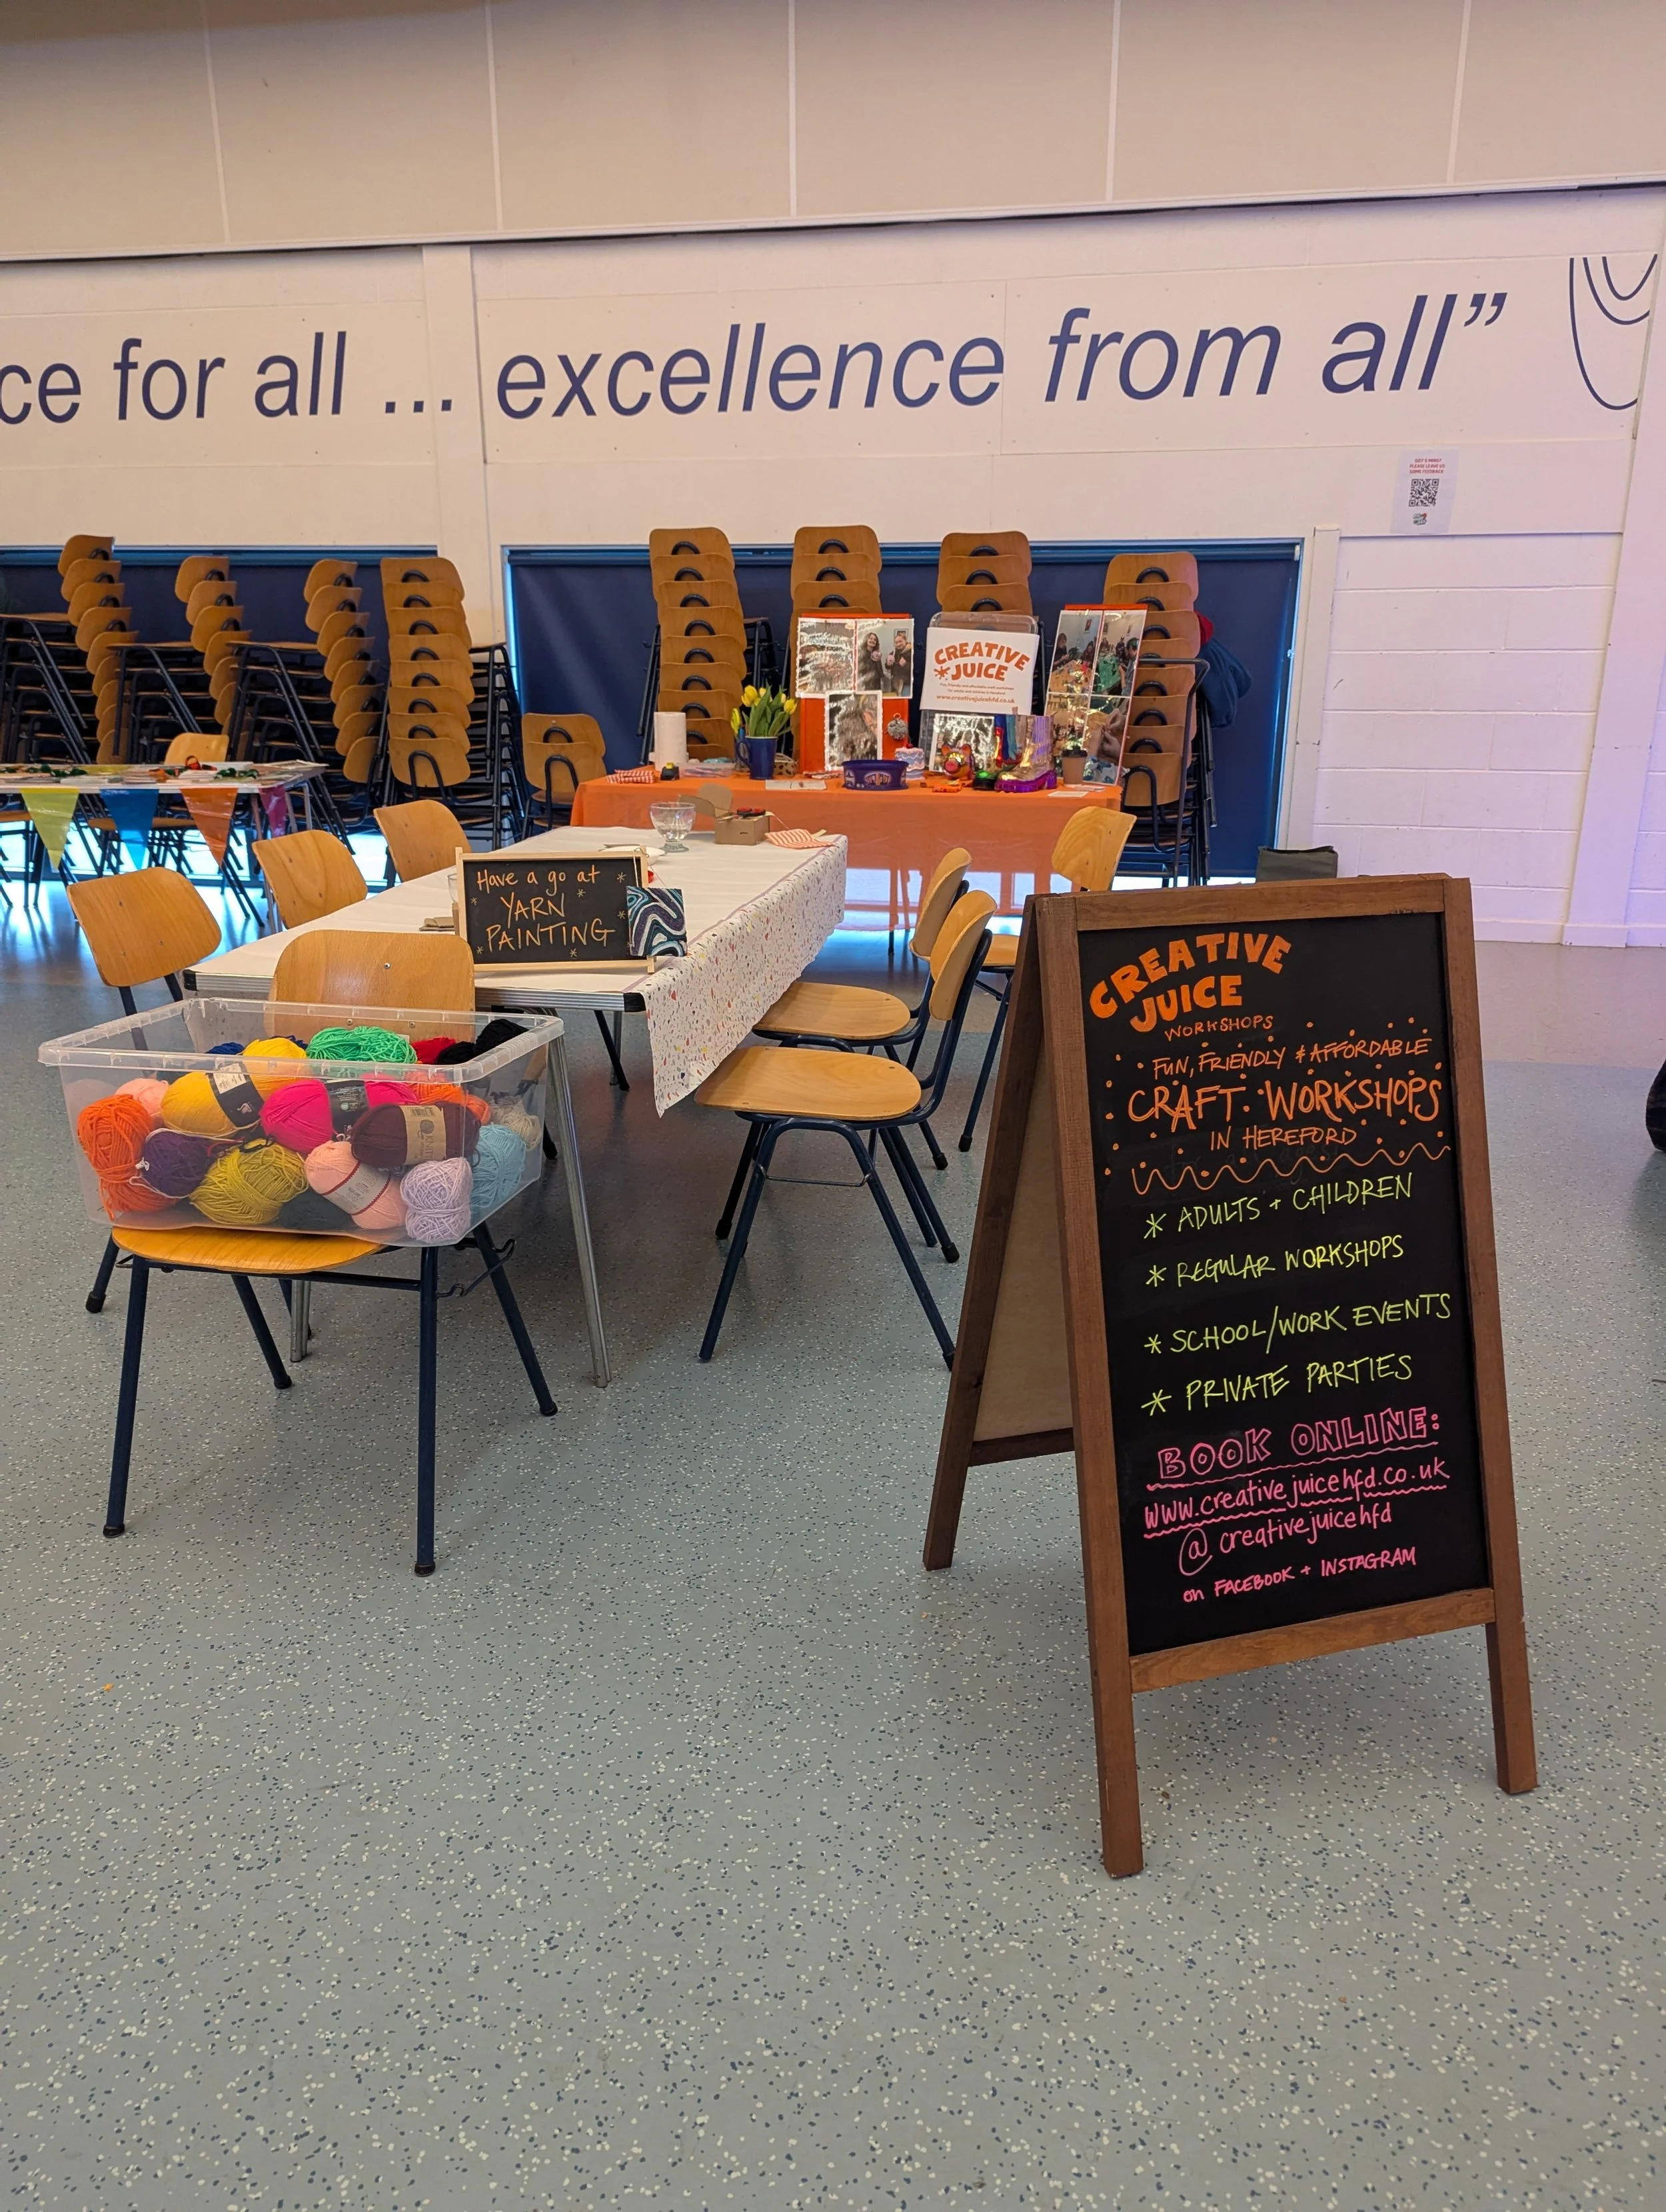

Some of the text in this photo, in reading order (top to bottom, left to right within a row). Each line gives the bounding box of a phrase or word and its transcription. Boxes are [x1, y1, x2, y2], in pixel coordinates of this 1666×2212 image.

[114, 337, 225, 420] for
[254, 330, 347, 416] all
[496, 322, 1004, 419] excellence
[1045, 306, 1281, 402] from
[935, 642, 1030, 671] CREATIVE
[951, 662, 1008, 682] JUICE
[936, 695, 1015, 704] www.creativejuicehfd.co.uk
[477, 864, 600, 896] Have a go at
[486, 918, 615, 952] PAINTING
[500, 891, 566, 929] YARN
[1089, 931, 1291, 1018] CREATIVE
[1130, 975, 1242, 1032] JUICE
[1165, 1015, 1273, 1041] WORKSHOPS
[1152, 1056, 1194, 1080] FUN,
[1198, 1047, 1286, 1072] FRIENDLY
[1309, 1038, 1432, 1063] AFFORDABLE
[1128, 1077, 1442, 1132] CRAFT WORKSHOPS
[1210, 1126, 1357, 1151] IN HEREFORD
[1178, 1197, 1261, 1232] ADULTS
[1293, 1172, 1412, 1214] CHILDREN
[1177, 1235, 1403, 1287] REGULAR WORKSHOPS
[1170, 1293, 1451, 1354] SCHOOL/WORK EVENTS
[1186, 1354, 1412, 1410] PRIVATE PARTIES
[1158, 1406, 1439, 1479] BOOK ONLINE:
[1183, 1588, 1204, 1602] on
[1214, 1566, 1295, 1597] FACEBOOK
[1321, 1546, 1417, 1577] INSTAGRAM
